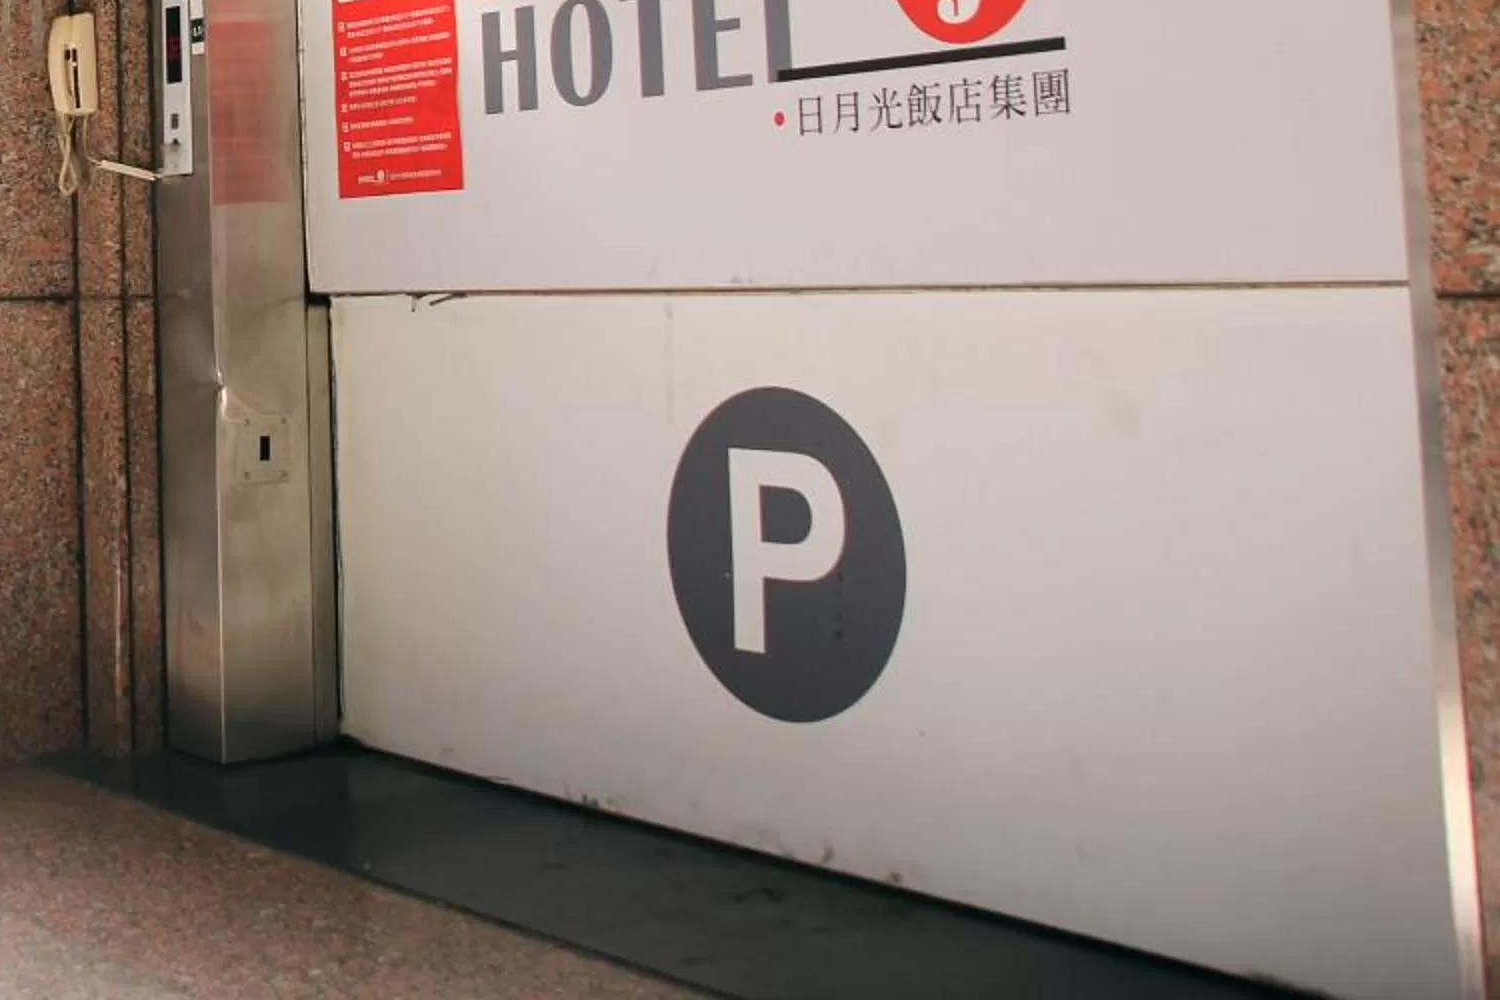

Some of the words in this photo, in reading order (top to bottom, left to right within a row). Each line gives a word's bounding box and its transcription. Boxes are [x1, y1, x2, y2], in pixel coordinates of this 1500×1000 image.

[797, 66, 1072, 137] 日月光飯店集團
[727, 446, 846, 654] P
